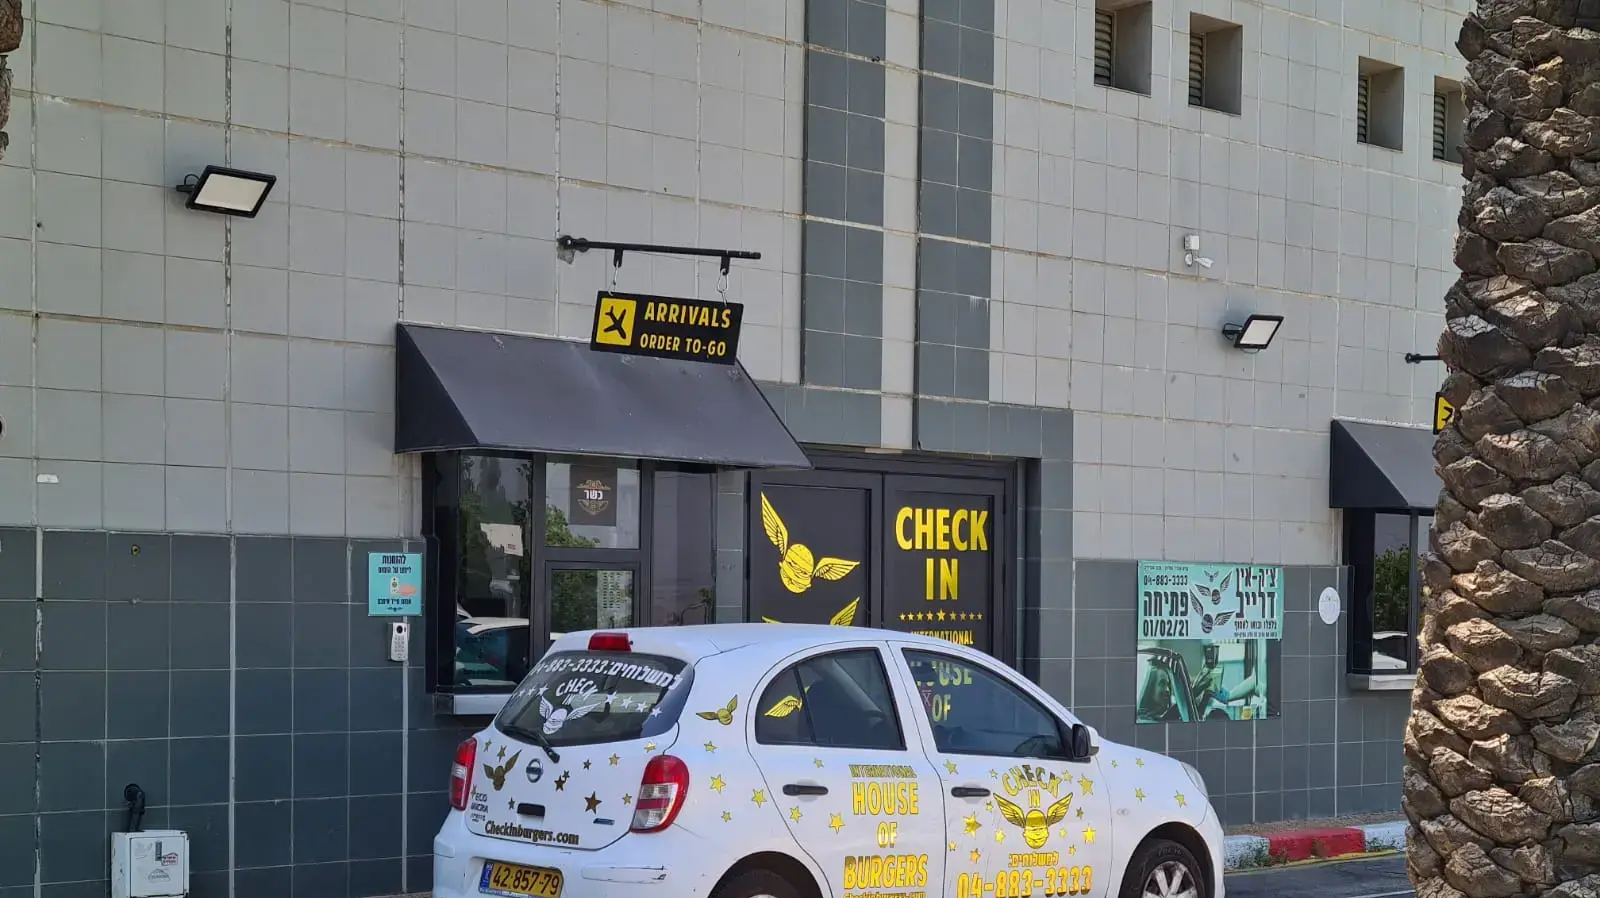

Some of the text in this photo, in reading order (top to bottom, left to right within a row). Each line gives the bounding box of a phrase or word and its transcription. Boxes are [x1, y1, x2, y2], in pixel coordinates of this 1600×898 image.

[644, 301, 732, 329] ARRIVALS
[640, 333, 726, 357] ORDER TO-GO
[584, 489, 603, 500] כשר
[895, 506, 989, 552] CHECK
[925, 558, 958, 601] IN
[1143, 575, 1188, 586] 04-883-3333
[1143, 591, 1189, 617] פתיחה
[1235, 591, 1276, 619] דרייב
[1142, 619, 1189, 638] 01/02/21
[555, 677, 599, 700] CHECK
[932, 693, 951, 722] OF
[1001, 764, 1063, 798] CHECK
[475, 792, 488, 802] ECO
[852, 781, 919, 816] HOUSE
[1027, 789, 1041, 808] IN
[484, 820, 580, 845] Checkinburgers.com
[876, 821, 898, 848] OF
[843, 853, 929, 890] BURGERS
[956, 865, 1093, 898] 04-883-3333
